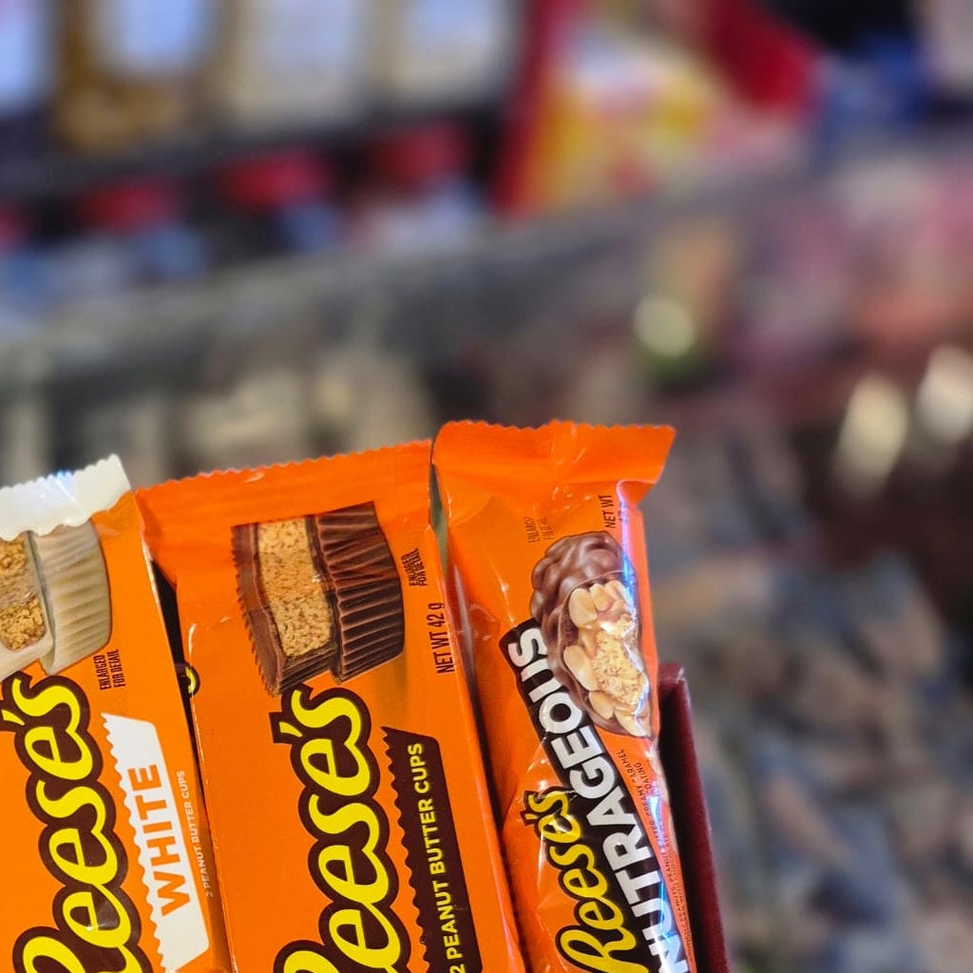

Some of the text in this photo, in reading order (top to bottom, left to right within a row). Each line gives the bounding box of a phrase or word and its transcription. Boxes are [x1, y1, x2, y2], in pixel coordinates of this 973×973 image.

[427, 613, 445, 628] 42
[430, 629, 451, 652] WT
[93, 654, 110, 691] ENLARGED
[107, 649, 126, 688] FOR DETAIL
[433, 655, 455, 674] NET
[176, 770, 191, 800] CUPS
[407, 742, 429, 794] CUPS
[127, 764, 190, 918] WHITE
[184, 801, 203, 844] BUTTER
[418, 799, 445, 875] BUTTER
[195, 844, 213, 889] PEANUT
[431, 881, 466, 960] PEANUT
